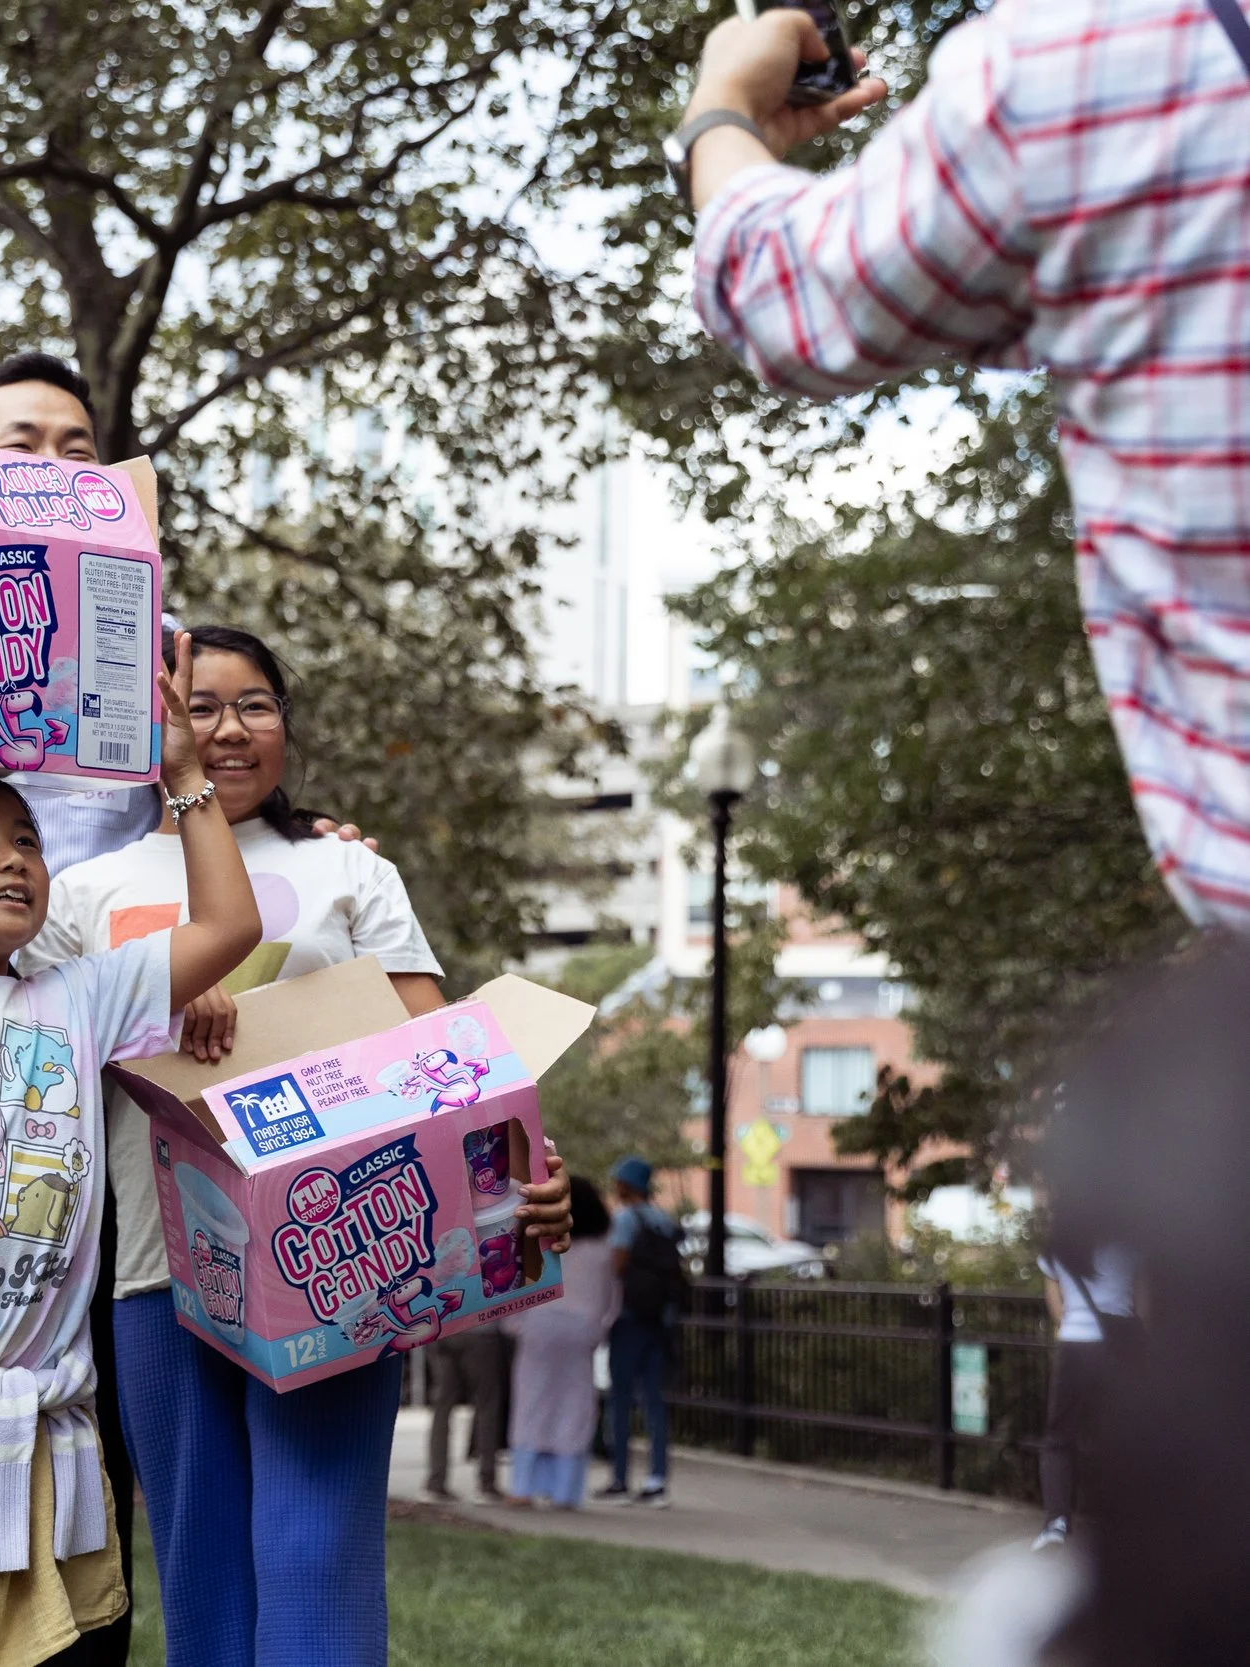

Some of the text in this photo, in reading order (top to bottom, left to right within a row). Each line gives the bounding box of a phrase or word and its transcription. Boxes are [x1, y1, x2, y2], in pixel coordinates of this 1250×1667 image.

[76, 482, 110, 492] sweets
[80, 491, 119, 510] FUN
[105, 570, 117, 579] FREE
[134, 575, 146, 584] FREE
[132, 584, 144, 592] FREE
[301, 1058, 342, 1077] GMO FREE
[306, 1070, 344, 1087] NUT FREE
[312, 1076, 363, 1097] GLUTEN FREE
[318, 1086, 370, 1108] PEANUT FREE
[252, 1115, 311, 1142] MADE IN USA
[258, 1126, 316, 1152] SINCE 1994
[350, 1145, 405, 1184] CLASSIC
[477, 1170, 495, 1186] FUN
[293, 1174, 334, 1212] FUN
[301, 1193, 338, 1222] sweets
[275, 1162, 430, 1284] COTTON
[213, 1249, 236, 1266] CLASSIC
[478, 1290, 555, 1322] 12 UNITS X 1.5 OZ EACH
